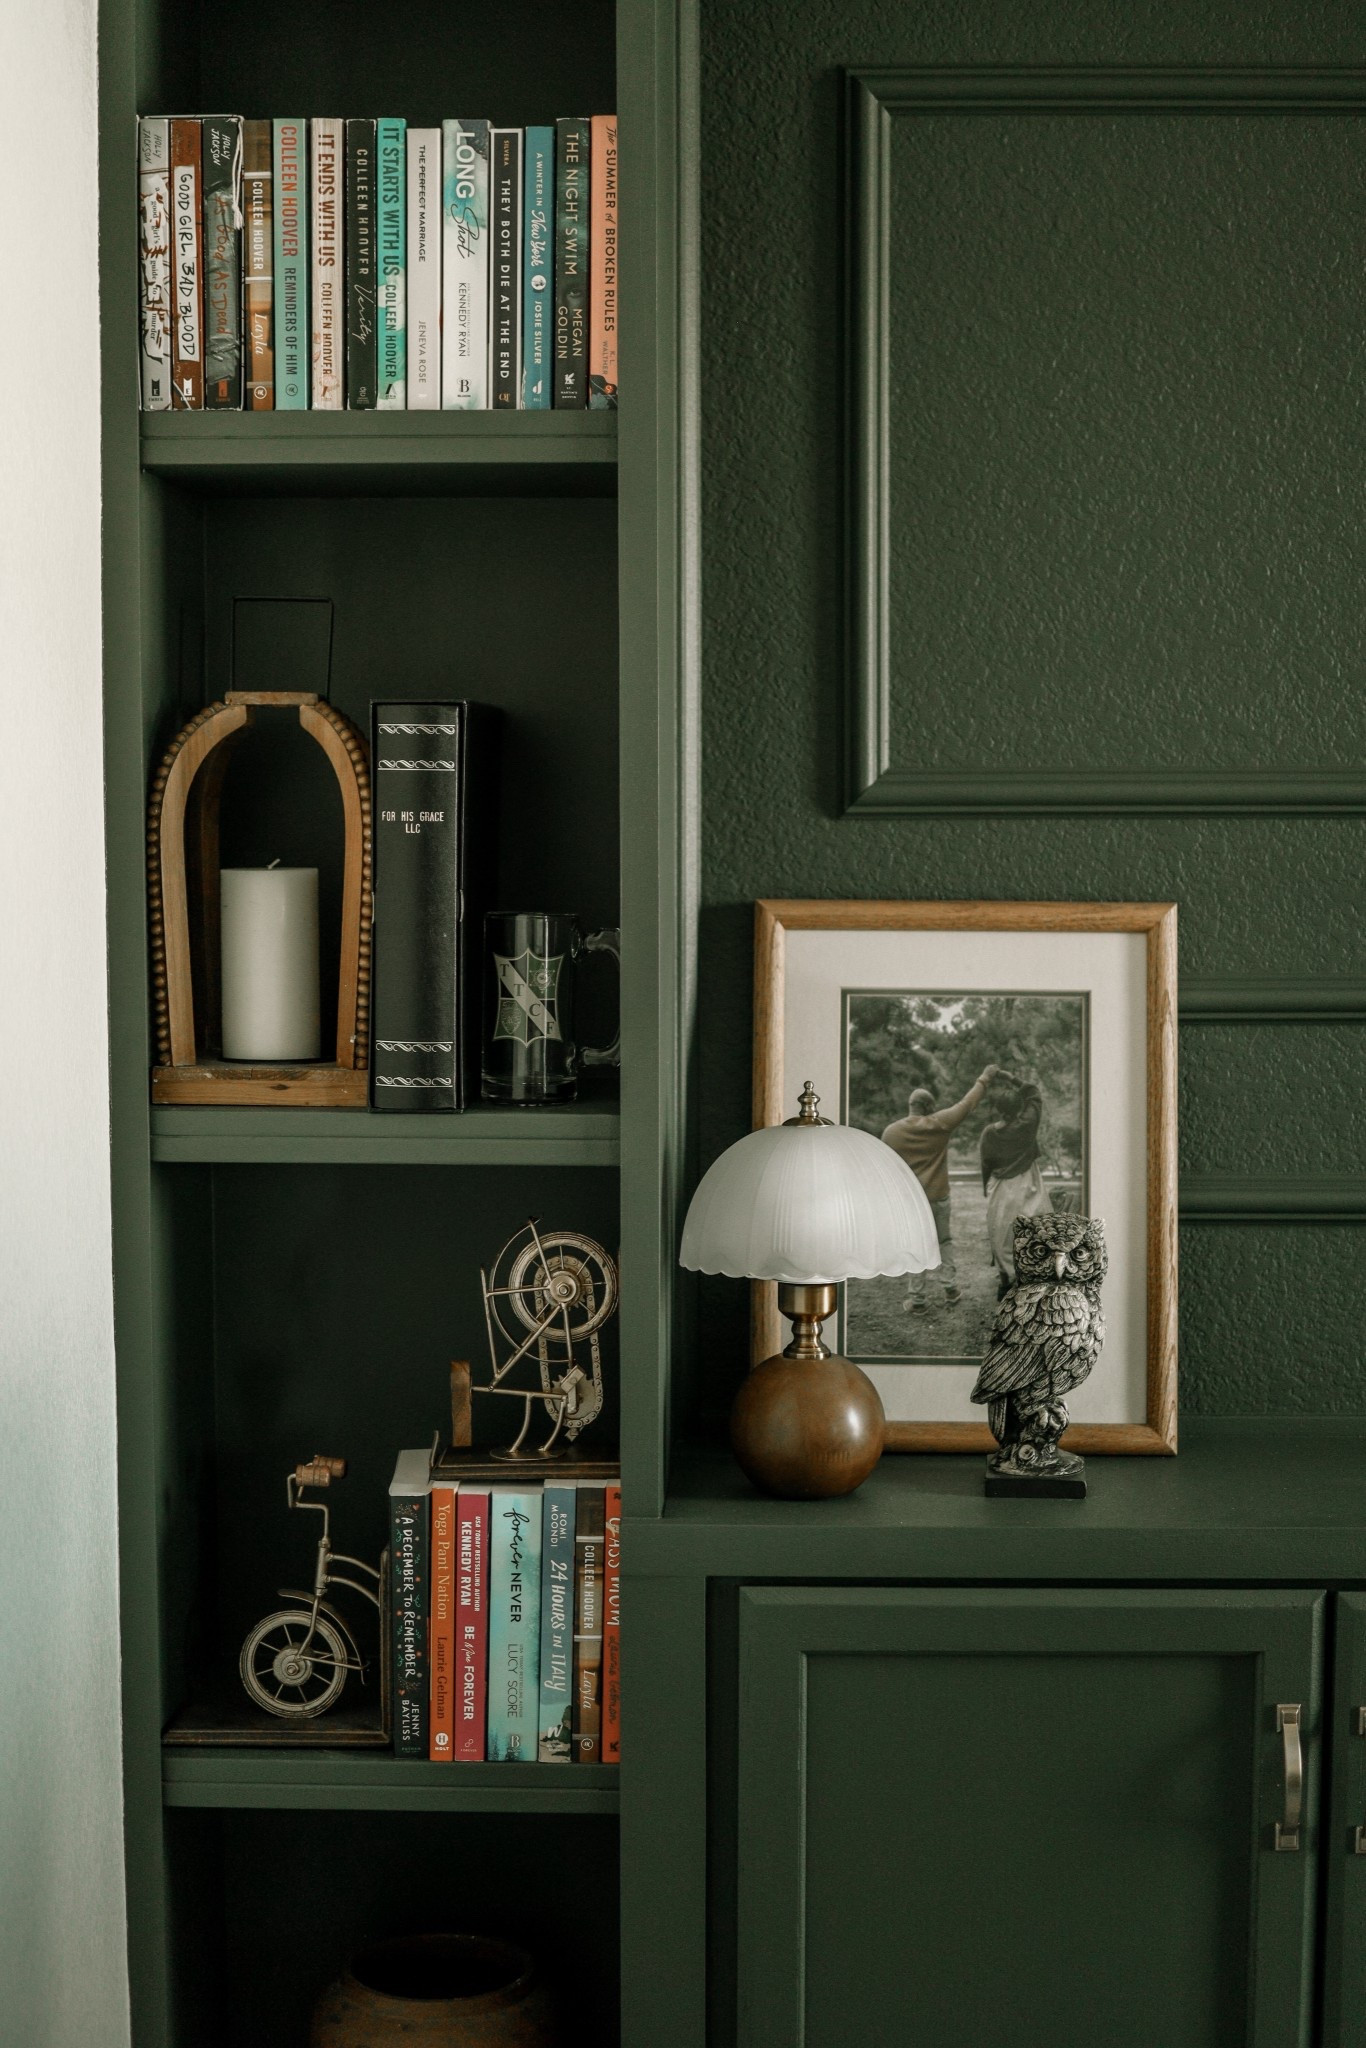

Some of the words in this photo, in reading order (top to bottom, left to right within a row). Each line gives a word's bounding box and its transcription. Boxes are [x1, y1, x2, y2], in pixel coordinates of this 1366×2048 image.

[142, 129, 151, 163] JACKSON
[211, 129, 221, 165] JACKSON
[222, 135, 230, 159] HOLLY
[319, 134, 334, 149] IT
[383, 128, 399, 141] IT
[565, 133, 579, 163] THE
[606, 125, 617, 145] The
[281, 126, 297, 191] COLLEEN
[319, 154, 334, 195] ENDS
[383, 148, 399, 203] STARTS
[456, 132, 475, 198] LONG
[178, 174, 192, 210] GOOD
[356, 149, 367, 210] COLLEEN
[501, 179, 510, 212] THEY
[565, 169, 578, 222] NIGHT
[606, 149, 616, 208] SUMMER
[151, 201, 159, 218] good
[253, 181, 263, 225] COLLEEN
[536, 197, 543, 206] IN
[605, 213, 616, 226] of
[151, 226, 159, 244] girl's
[180, 216, 192, 256] GIRL,
[282, 198, 298, 256] HOOVER
[319, 201, 334, 241] WITH
[383, 210, 399, 249] WITH
[450, 204, 480, 259] Shot
[501, 221, 510, 256] BOTH
[530, 210, 546, 239] New
[213, 225, 235, 261] Good
[254, 230, 264, 269] HOOVER
[319, 246, 334, 266] US
[358, 217, 368, 275] HOOVER
[531, 241, 545, 266] York
[565, 228, 577, 274] SWIM
[605, 229, 615, 285] BROKEN
[150, 260, 158, 280] guide
[181, 263, 194, 296] BAD
[383, 255, 399, 275] US
[501, 265, 510, 286] DIE
[211, 294, 231, 334] Dead
[285, 268, 296, 332] REMINDERS
[322, 283, 332, 329] COLLEEN
[353, 285, 373, 345] Verity
[385, 285, 396, 330] COLLEEN
[458, 283, 467, 327] KENNEDY
[501, 295, 510, 312] AT
[534, 301, 542, 327] JOSIE
[605, 290, 615, 331] RULES
[180, 302, 195, 355] BLOOD
[251, 313, 267, 355] Layla
[285, 336, 297, 349] OF
[458, 332, 468, 357] RYAN
[501, 320, 510, 344] THE
[534, 331, 542, 363] SILVER
[558, 307, 567, 358] GOLDIN
[572, 309, 582, 356] MEGAN
[286, 355, 297, 375] HIM
[322, 333, 333, 375] HOOVER
[386, 335, 396, 377] HOOVER
[501, 351, 510, 379] END
[381, 811, 396, 821] FOR
[401, 811, 414, 821] HIS
[419, 811, 445, 822] GRACE
[405, 823, 420, 834] LLC
[435, 1505, 450, 1535] Yoga
[504, 1508, 529, 1569] forever
[550, 1505, 558, 1547] MOONDI
[559, 1513, 567, 1539] ROMI
[403, 1529, 414, 1591] DECEMBER
[438, 1541, 450, 1570] Pant
[461, 1521, 471, 1572] KENNEDY
[550, 1560, 568, 1581] 24
[584, 1546, 595, 1587] COLLEEN
[438, 1575, 450, 1620] Nation
[461, 1577, 470, 1605] RYAN
[510, 1573, 521, 1622] NEVER
[552, 1585, 565, 1629] HOURS
[584, 1591, 595, 1629] HOOVER
[404, 1611, 417, 1677] REMEMBER
[464, 1626, 474, 1639] BE
[553, 1634, 562, 1647] IN
[437, 1637, 447, 1672] Laurie
[461, 1642, 475, 1662] Mine
[508, 1644, 518, 1673] LUCY
[545, 1654, 566, 1691] ITALY
[580, 1670, 595, 1709] Layla
[437, 1677, 447, 1719] Gelman
[464, 1666, 474, 1720] FOREVER
[508, 1681, 518, 1717] SCORE
[402, 1700, 410, 1741] BAYLISS
[411, 1703, 419, 1737] JENNY
